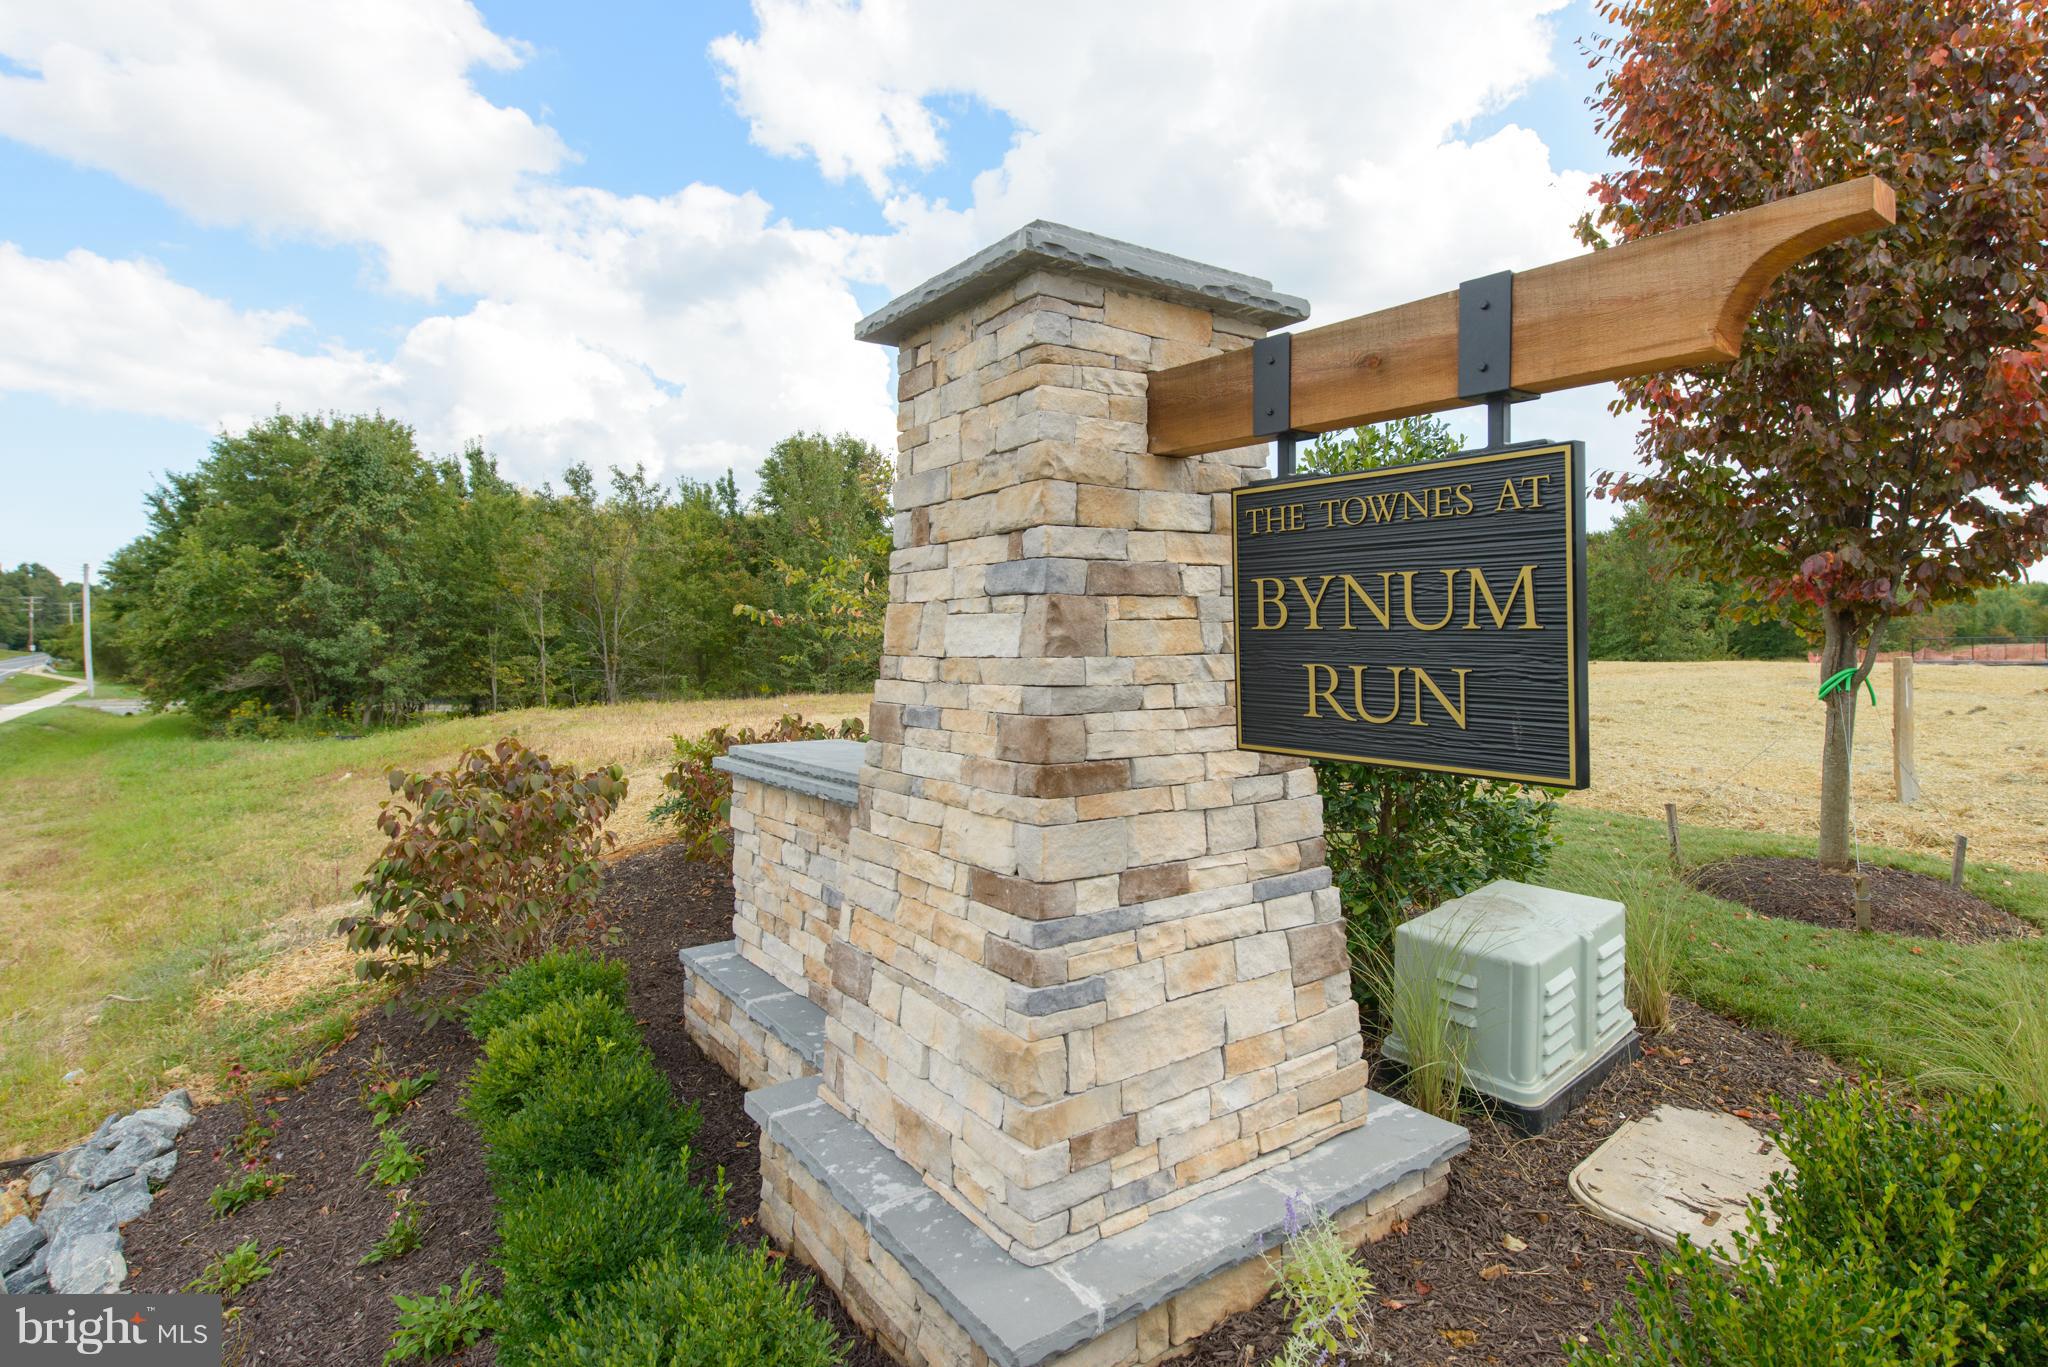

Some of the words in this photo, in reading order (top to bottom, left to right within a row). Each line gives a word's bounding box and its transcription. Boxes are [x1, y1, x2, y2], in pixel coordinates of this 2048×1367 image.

[1245, 503, 1306, 535] THE
[1320, 483, 1474, 528] TOWNES
[1494, 474, 1551, 512] AT
[1251, 564, 1545, 631] BYNUM
[1302, 663, 1473, 731] RUN
